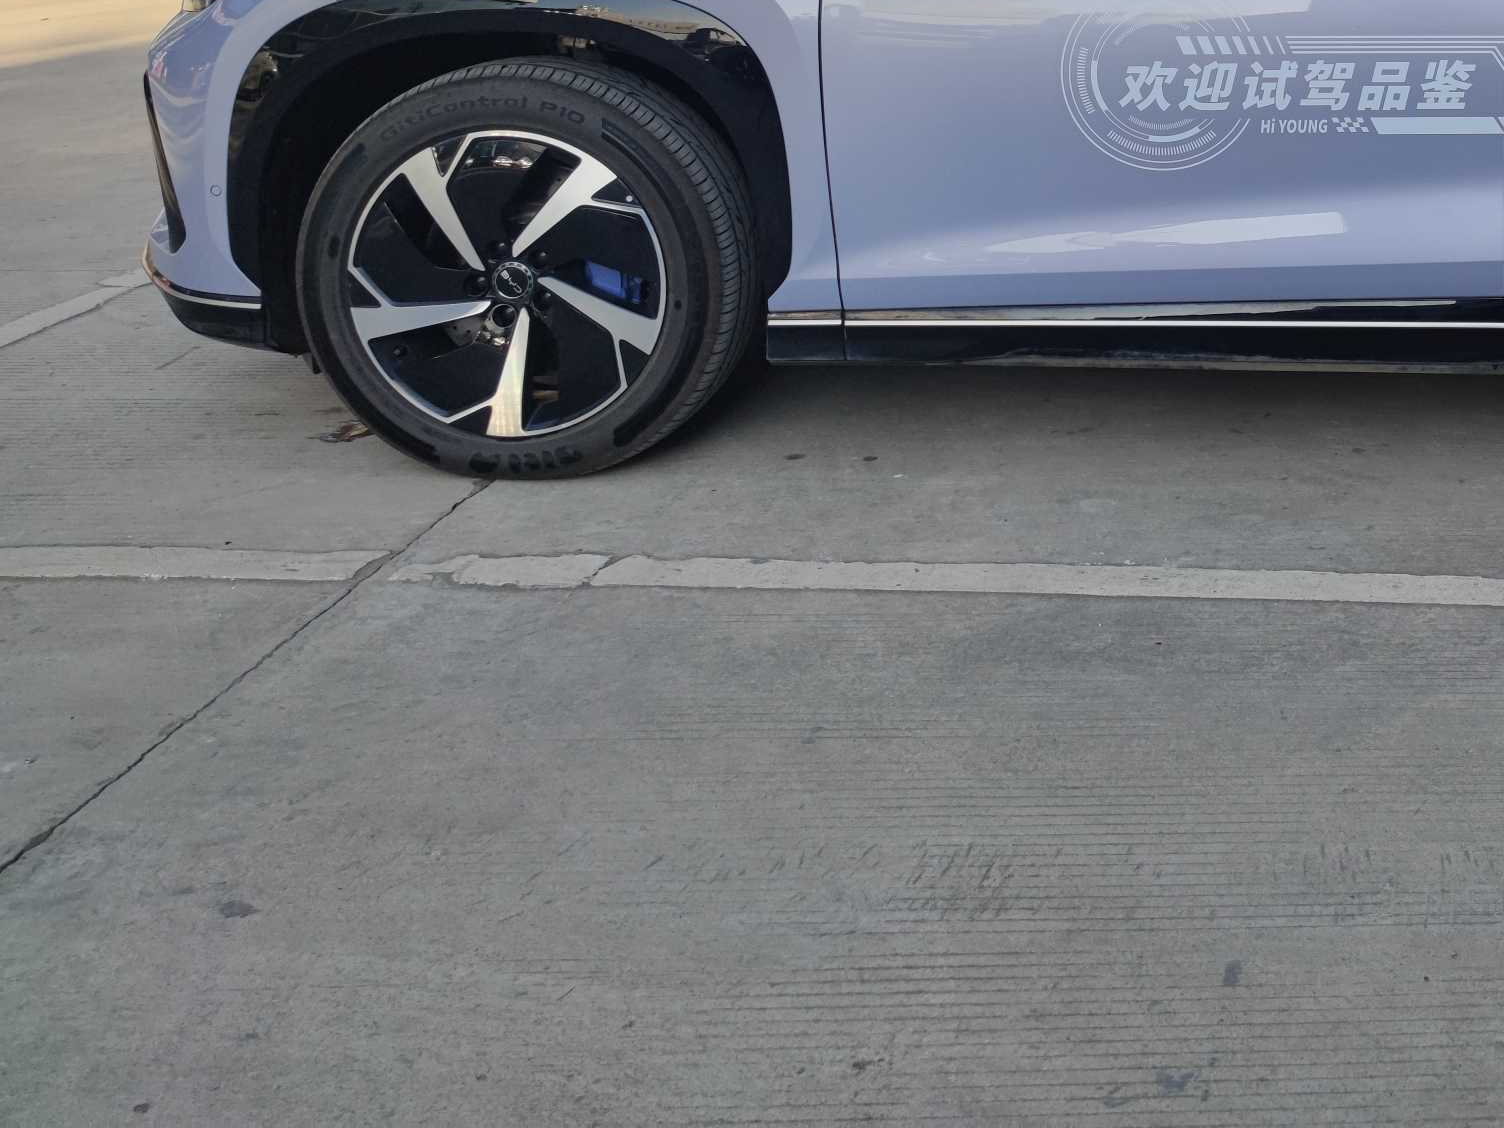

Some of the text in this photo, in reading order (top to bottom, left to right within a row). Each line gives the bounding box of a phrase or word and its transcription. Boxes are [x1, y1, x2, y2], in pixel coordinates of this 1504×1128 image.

[1118, 59, 1477, 112] 欢迎试驾品鉴
[538, 100, 585, 125] P10
[1260, 118, 1328, 135] Hi YOUNG
[500, 269, 523, 294] BYD
